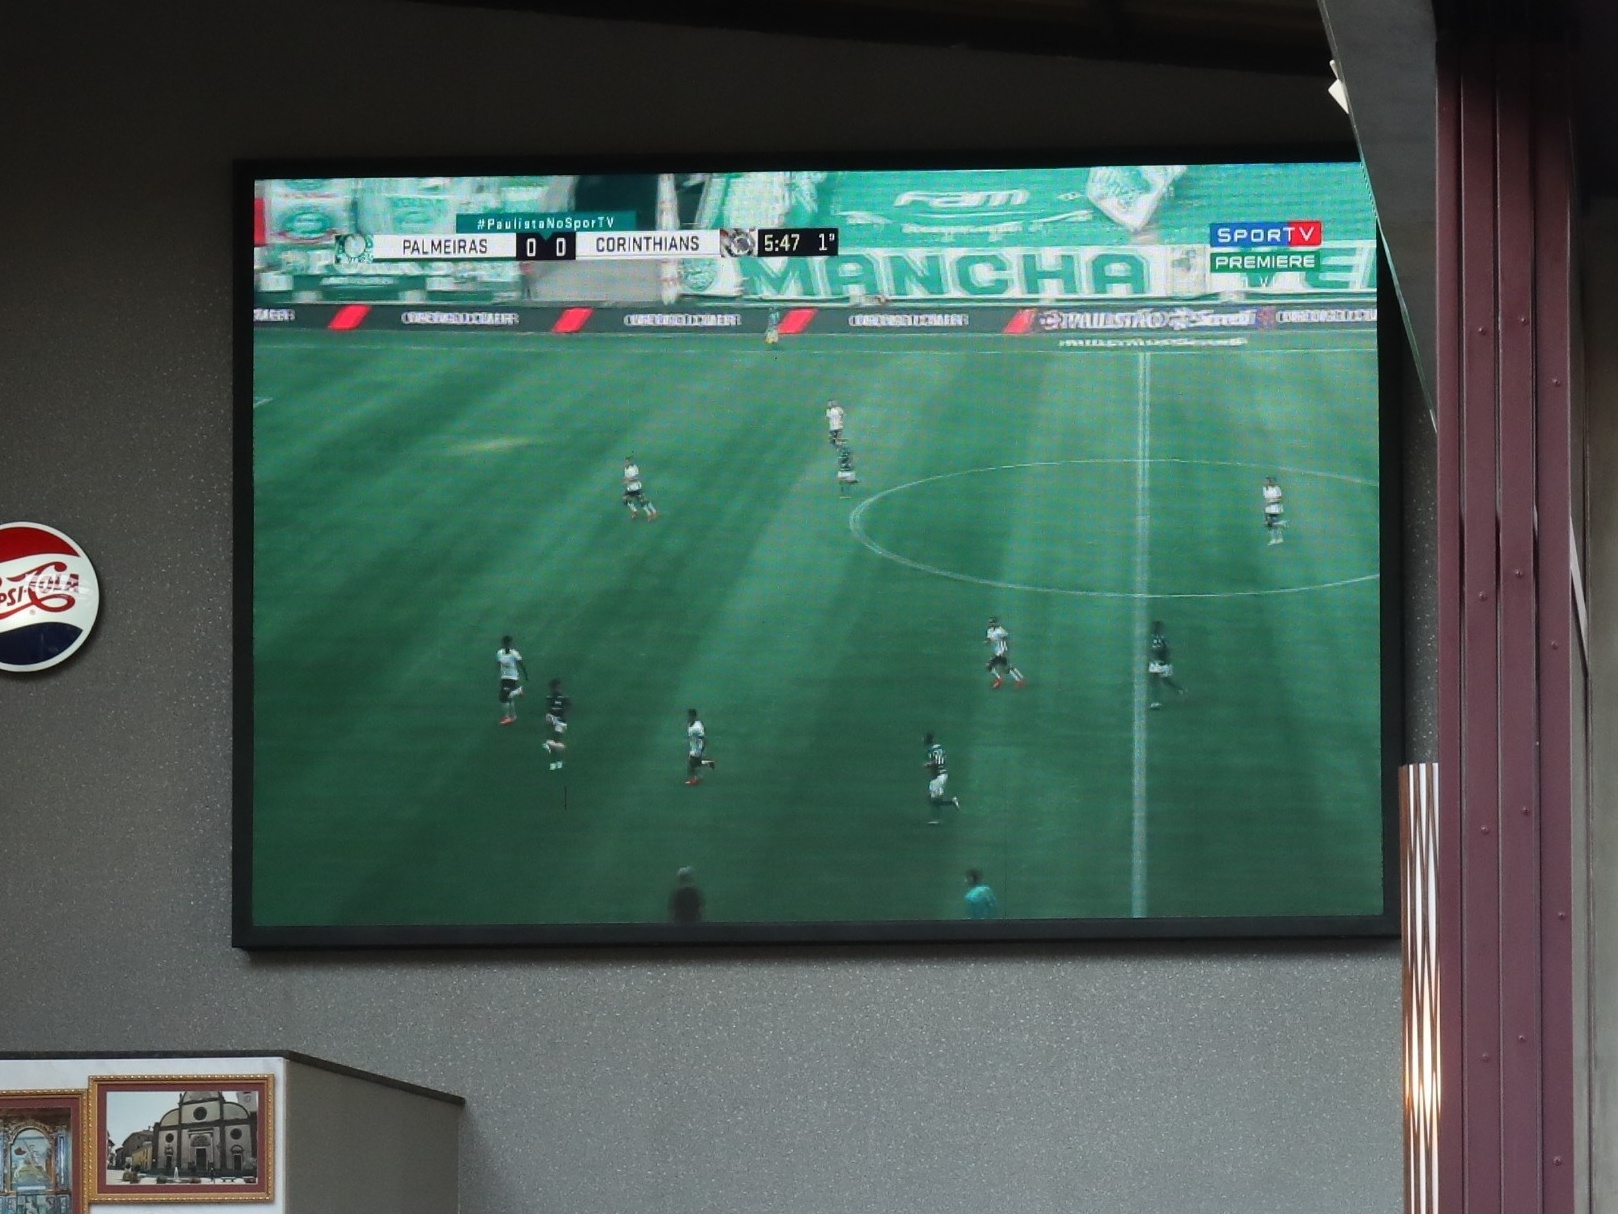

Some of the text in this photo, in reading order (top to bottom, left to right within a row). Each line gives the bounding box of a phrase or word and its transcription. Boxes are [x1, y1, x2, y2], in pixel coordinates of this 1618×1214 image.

[477, 216, 615, 231] #PaulistaNoSporTV
[1217, 226, 1315, 243] SPORTV
[402, 239, 488, 255] PALMEIRAS
[526, 237, 537, 257] 0
[556, 236, 567, 257] 0
[596, 236, 700, 254] CORINTHIANS
[764, 233, 800, 252] 5:47
[1215, 254, 1316, 270] PREMIERE
[738, 252, 1151, 298] MANCHA
